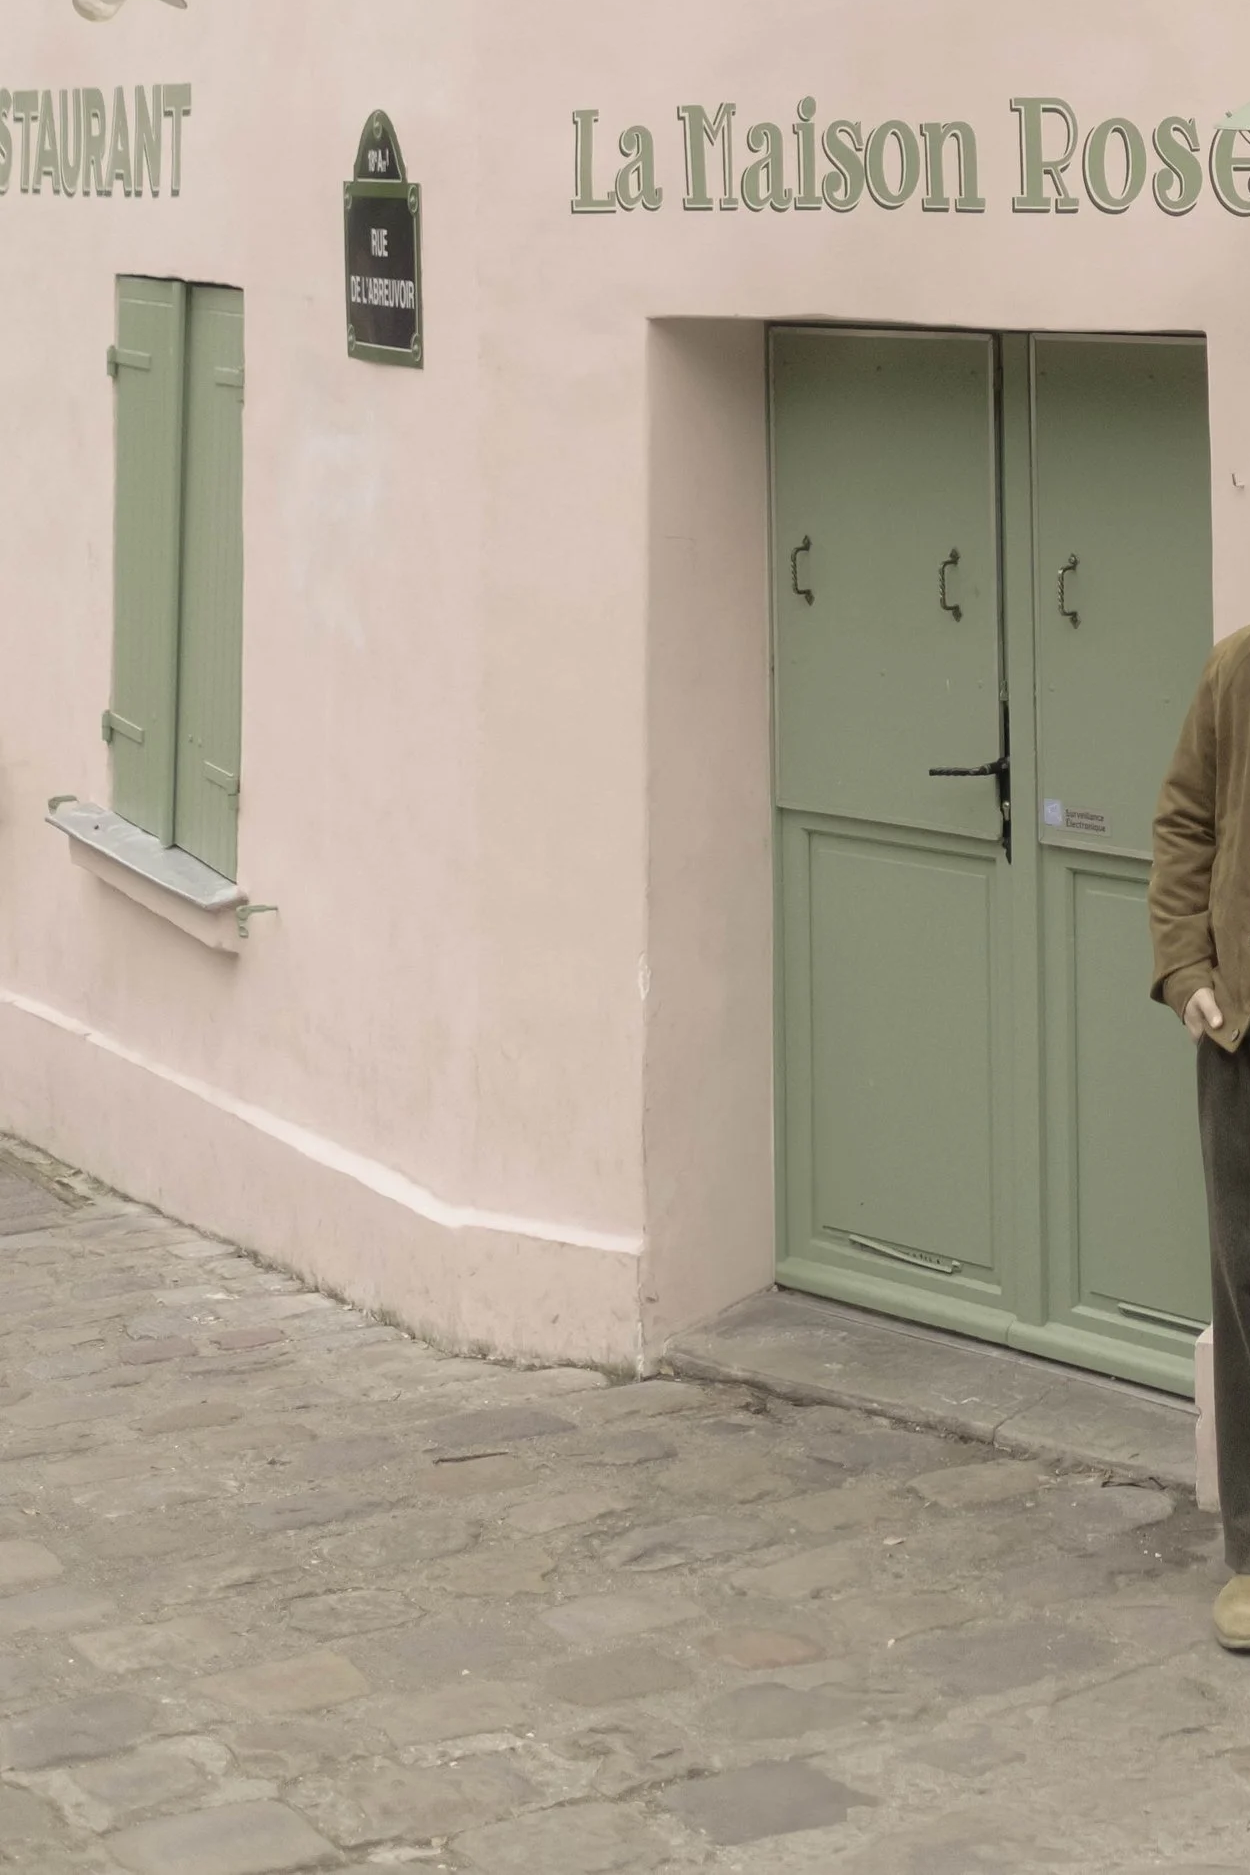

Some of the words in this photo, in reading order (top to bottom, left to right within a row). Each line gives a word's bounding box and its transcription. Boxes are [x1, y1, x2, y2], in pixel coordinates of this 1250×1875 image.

[571, 108, 663, 214] La
[678, 95, 986, 214] Maison
[371, 228, 388, 258] RUE
[351, 275, 361, 303] DE
[361, 276, 415, 309] L'ABREUVOIR
